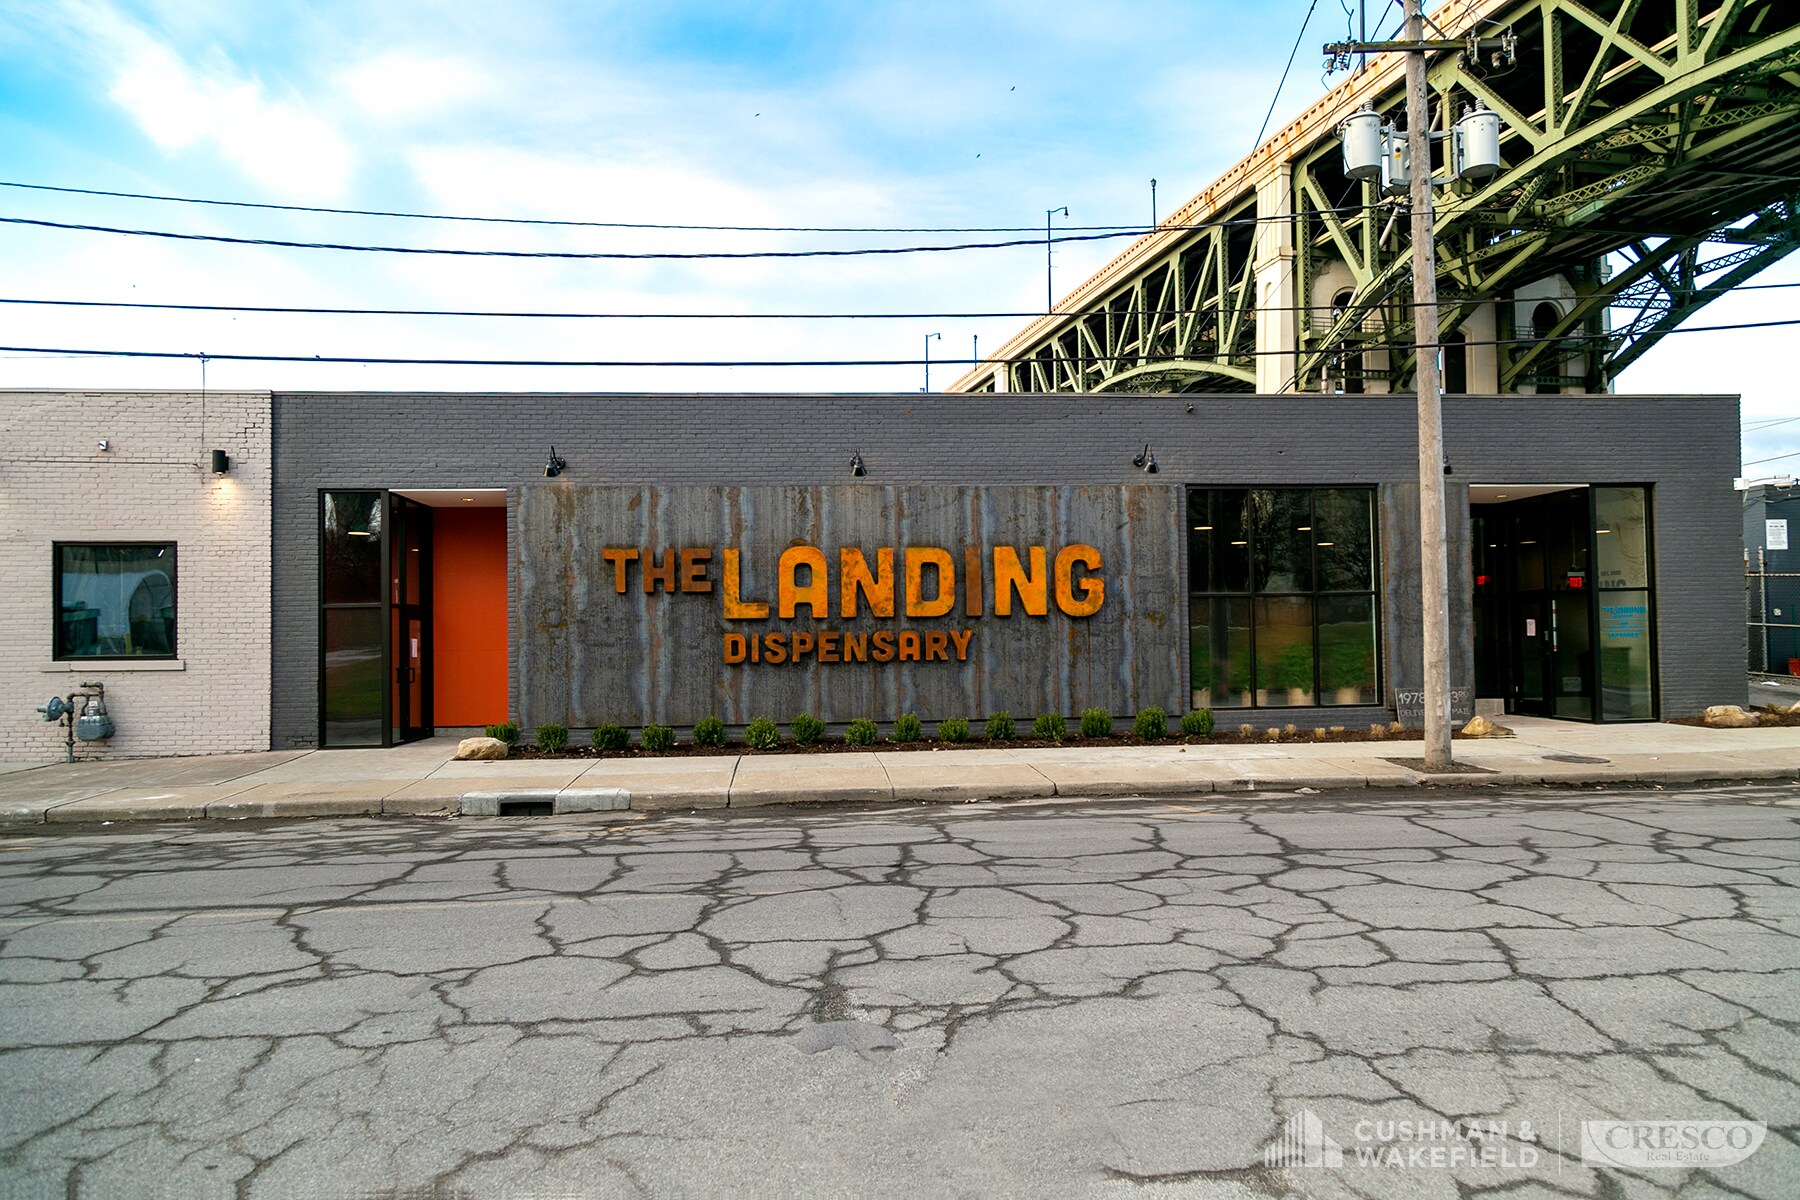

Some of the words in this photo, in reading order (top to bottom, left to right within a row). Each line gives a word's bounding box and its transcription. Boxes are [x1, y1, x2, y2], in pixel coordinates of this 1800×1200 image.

[602, 547, 713, 594] THE
[723, 544, 1105, 620] LANDING
[723, 629, 974, 665] DISPENSARY
[1399, 692, 1425, 704] 1978
